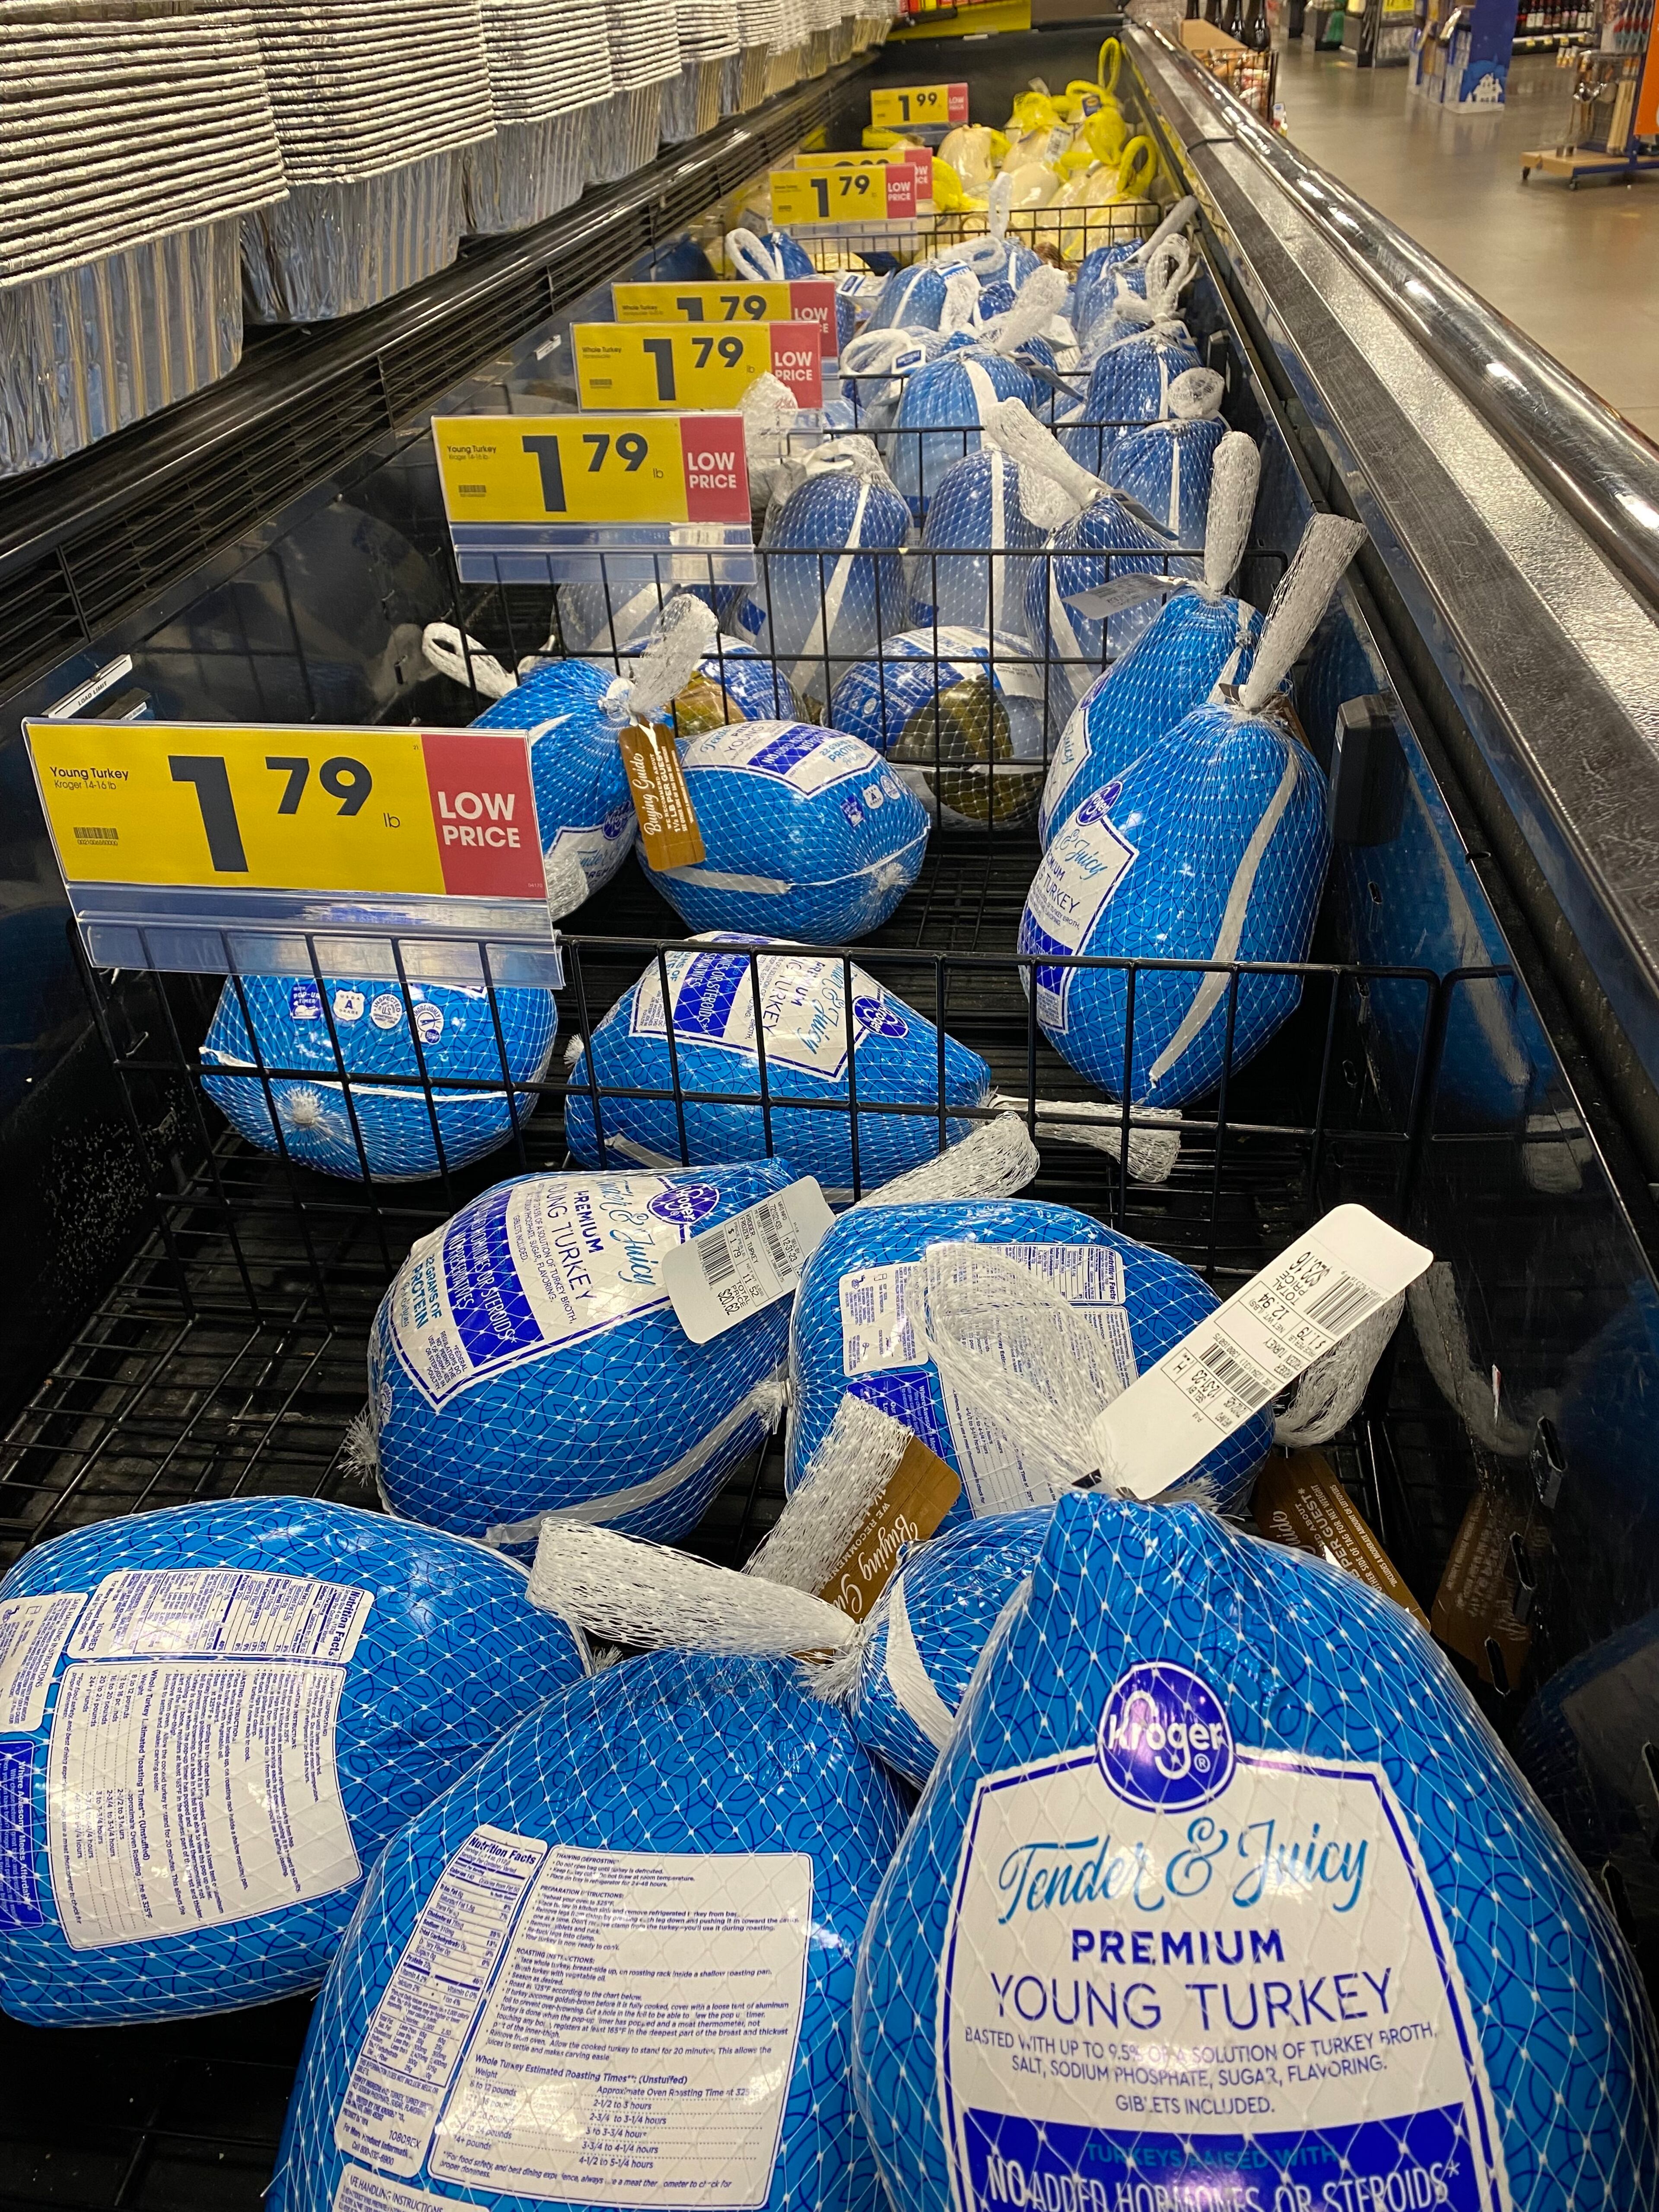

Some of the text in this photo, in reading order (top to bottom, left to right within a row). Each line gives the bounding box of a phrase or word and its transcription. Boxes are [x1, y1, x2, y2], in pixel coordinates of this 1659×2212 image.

[898, 92, 937, 121] 1 99
[810, 174, 870, 217] 1 79
[887, 182, 910, 193] LOW
[720, 295, 767, 321] 79
[794, 307, 828, 321] LOW
[643, 336, 755, 400] 1 79 lb
[774, 351, 813, 367] LOW
[775, 369, 813, 381] PRICE
[447, 445, 496, 454] Young Turkey
[687, 451, 735, 471] LOW
[521, 432, 664, 512] 1 79 lb
[690, 474, 737, 489] PRICE
[78, 680, 108, 706] LOAD LIMIT
[723, 725, 764, 753] YOUNG
[761, 753, 778, 764] NO
[49, 766, 129, 781] Young Turkey
[54, 780, 116, 791] Kroger 14-16 lb
[629, 752, 663, 836] Buying Guide
[649, 753, 672, 830] WE RECOMMEND ABOUT
[871, 792, 877, 801] A
[168, 754, 400, 872] 1 79 lb
[437, 791, 515, 821] LOW
[442, 825, 521, 848] PRICE
[1065, 839, 1108, 881] Juicy
[1042, 873, 1081, 914] TURKEY
[708, 971, 725, 984] OR
[344, 1000, 353, 1009] A
[373, 996, 401, 1013] INSPECTED
[797, 998, 839, 1055] Juicy
[663, 1187, 705, 1222] Kroger
[573, 1189, 604, 1254] PREMIUM
[745, 1214, 756, 1237] KROGER
[470, 1230, 491, 1274] HORMONES
[546, 1180, 597, 1300] YOUNG TURKEY
[739, 1217, 759, 1263] FROZEN TURKEY
[782, 1236, 798, 1262] 12-31-23
[449, 1246, 474, 1310] PRESERVATIVES
[477, 1270, 495, 1289] OR
[1279, 1270, 1309, 1296] PRICE
[1289, 1251, 1333, 1287] $23.16
[411, 1262, 429, 1330] PROTEIN
[426, 1268, 442, 1319] GRAMS OF
[716, 1288, 741, 1316] $20.62
[731, 1284, 747, 1308] PRICE
[735, 1279, 751, 1305] TOTAL
[1258, 1292, 1290, 1320] 12.94
[1272, 1278, 1300, 1306] TOTAL
[1297, 1326, 1320, 1345] 1.79
[1329, 1484, 1348, 1508] LEFTOVERS
[1294, 1503, 1317, 1532] ABOUT
[1343, 1506, 1353, 1515] OF
[1348, 1513, 1365, 1535] AMOUNT
[859, 1514, 919, 1581] Buying
[1310, 1484, 1382, 1592] OTHER SIDE OF TAG FOR NET WEIGHT
[1361, 1535, 1381, 1560] MODERATE
[1329, 1538, 1353, 1568] PER
[328, 1590, 361, 1657] Nutrition Facts
[142, 1694, 153, 1719] Turkey
[1107, 1688, 1224, 1780] Kroger
[468, 1836, 537, 1865] Nutrition Facts
[997, 1816, 1368, 1926] Tender & Juicy
[1071, 1928, 1286, 1967] PREMIUM
[989, 1966, 1393, 2032] YOUNG TURKEY
[965, 2026, 1014, 2048] BASTED
[1019, 2036, 1056, 2054] WITH
[1059, 2040, 1079, 2056] UP
[1083, 2042, 1104, 2059] TO
[1108, 2044, 1142, 2062] 9.5%
[1192, 2044, 1278, 2064] SOLUTION
[1283, 2042, 1306, 2059] OF
[1310, 2032, 1374, 2057] TURKEY
[1380, 2021, 1438, 2047] BROTH,
[475, 2066, 498, 2079] Weight
[1011, 2054, 1388, 2090] SALT, SODIUM PHOSPHATE, SUGAR, FLAVORING.
[589, 2113, 610, 2122] 2-3/4
[623, 2115, 643, 2123] 3-1/4
[645, 2116, 667, 2125] hours
[1185, 2096, 1275, 2115] INCLUDED.
[614, 2143, 658, 2154] 4-1/4 hours
[1086, 2142, 1180, 2168] TURKEYS
[1274, 2144, 1339, 2168] WITH
[609, 2159, 653, 2169] 5-1/4 hours
[987, 2154, 1026, 2206] NO
[1274, 2185, 1312, 2212] OR
